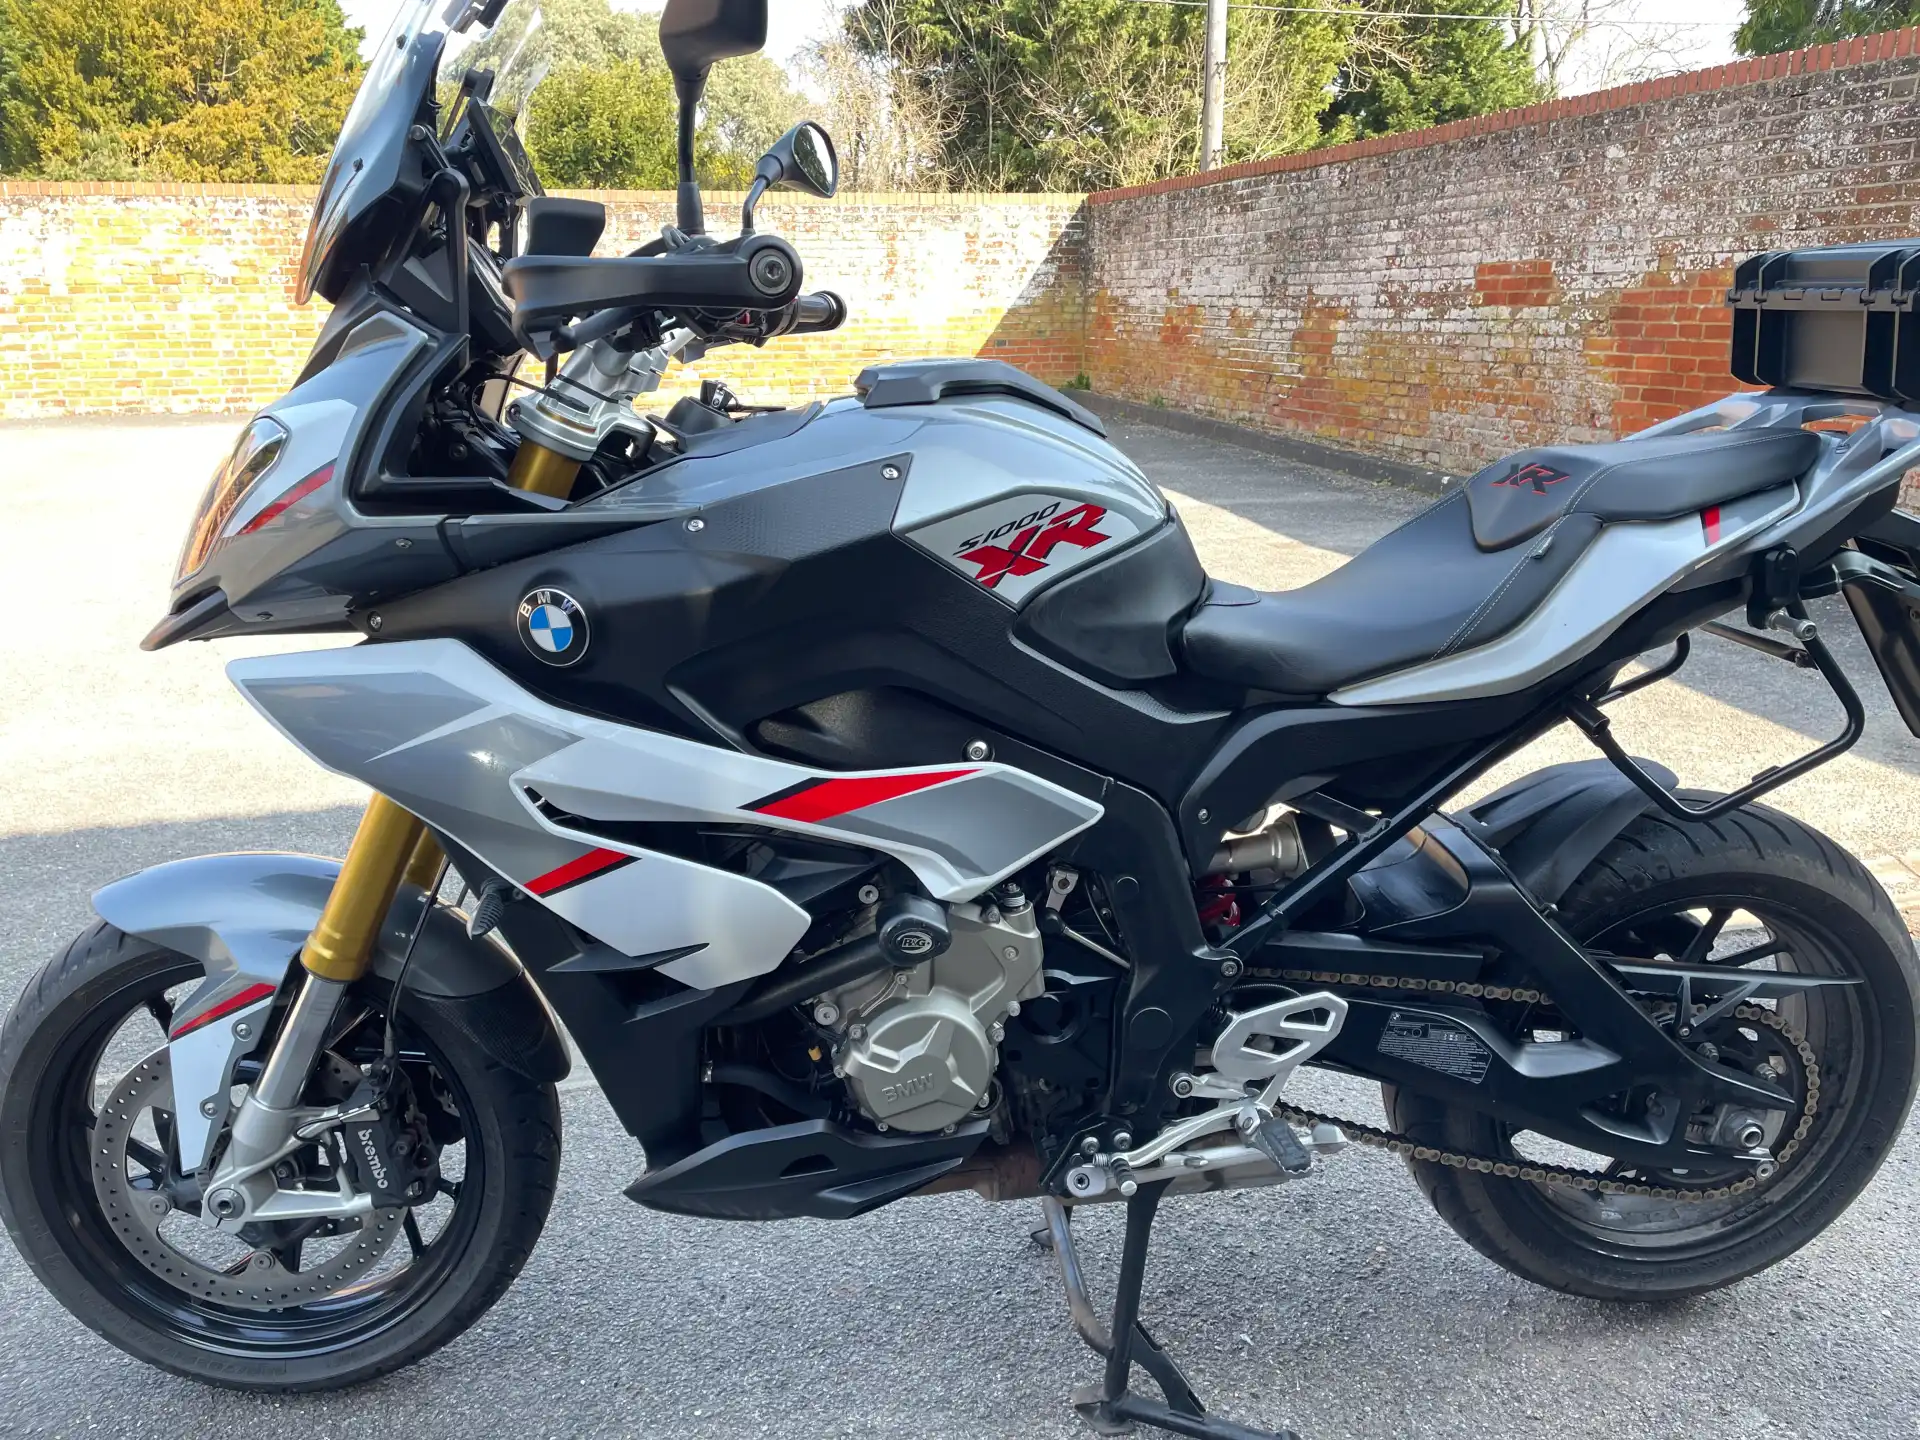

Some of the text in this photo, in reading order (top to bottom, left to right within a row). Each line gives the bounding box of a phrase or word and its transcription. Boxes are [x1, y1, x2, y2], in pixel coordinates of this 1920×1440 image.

[1490, 462, 1570, 496] XR
[952, 501, 1062, 556] S1000
[957, 503, 1112, 588] XR
[519, 591, 577, 618] BMW
[881, 1073, 934, 1102] BMW
[358, 1128, 388, 1189] brembo
